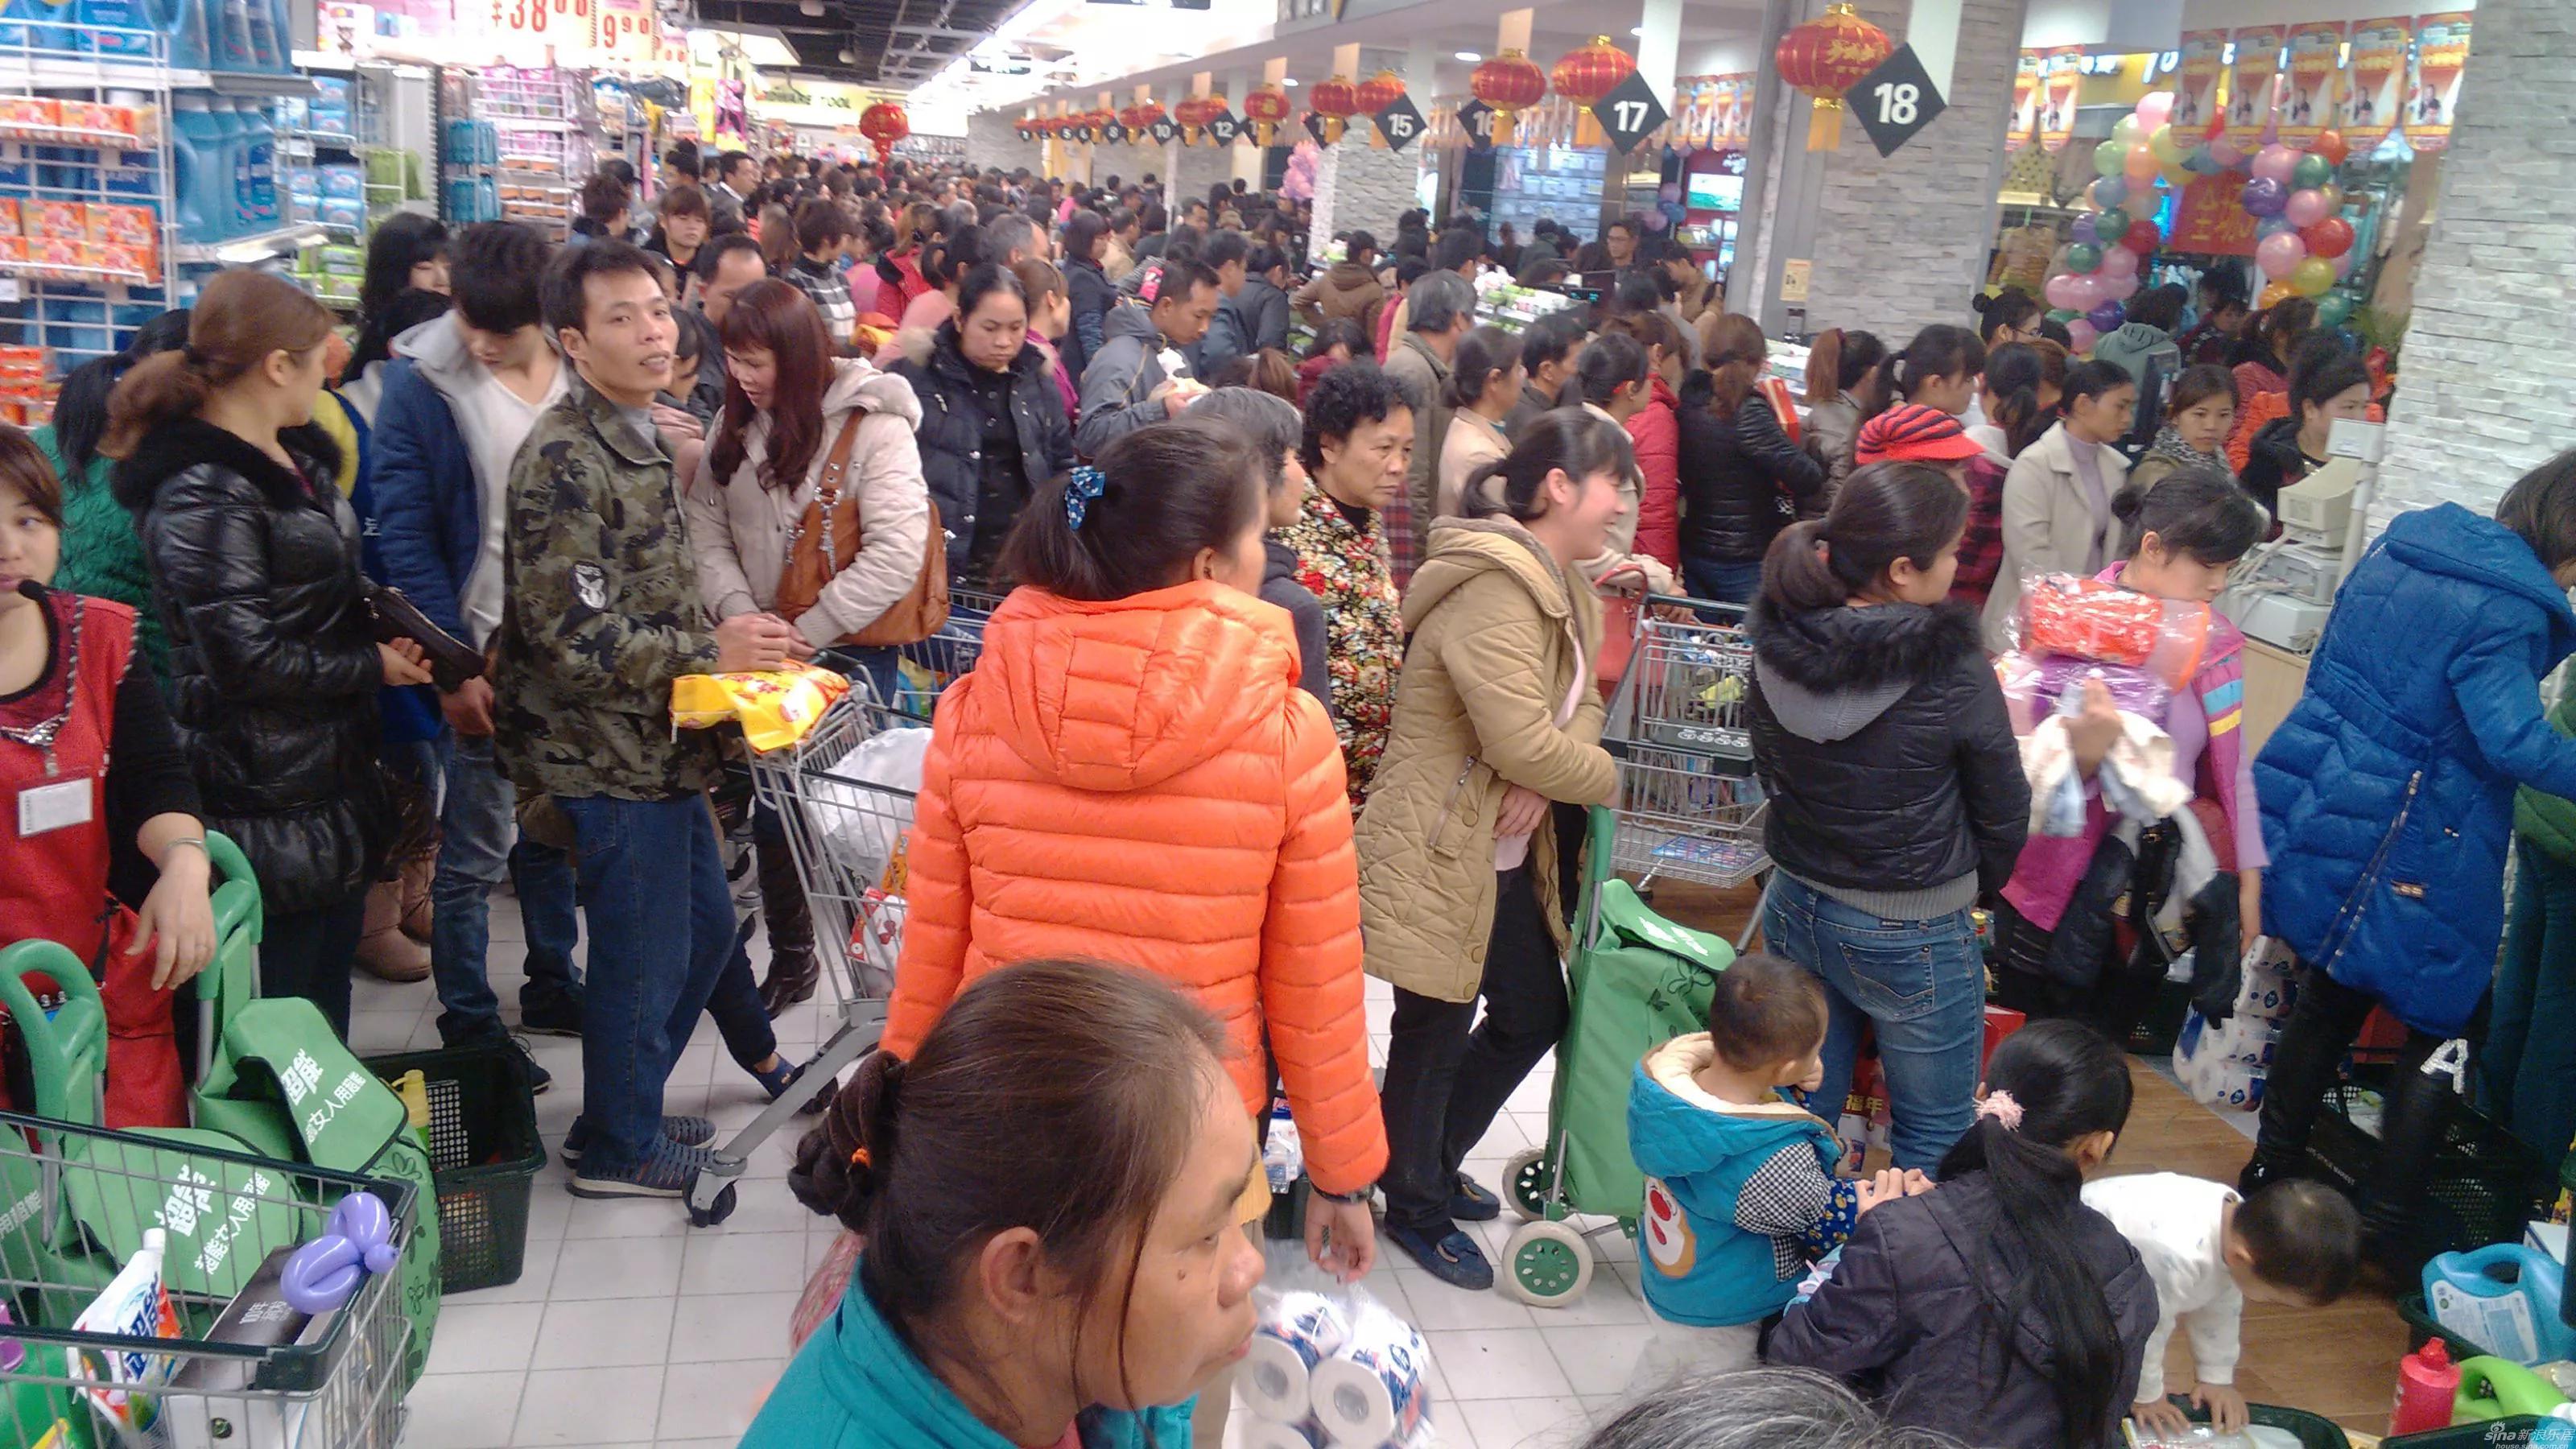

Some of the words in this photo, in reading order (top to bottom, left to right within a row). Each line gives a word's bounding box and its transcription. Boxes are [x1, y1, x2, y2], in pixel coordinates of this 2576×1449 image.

[1613, 100, 1649, 133] 17
[1873, 82, 1921, 126] 18
[1153, 123, 1172, 139] 10
[1214, 121, 1235, 139] 12
[1387, 113, 1414, 138] 15
[2420, 1038, 2468, 1094] A
